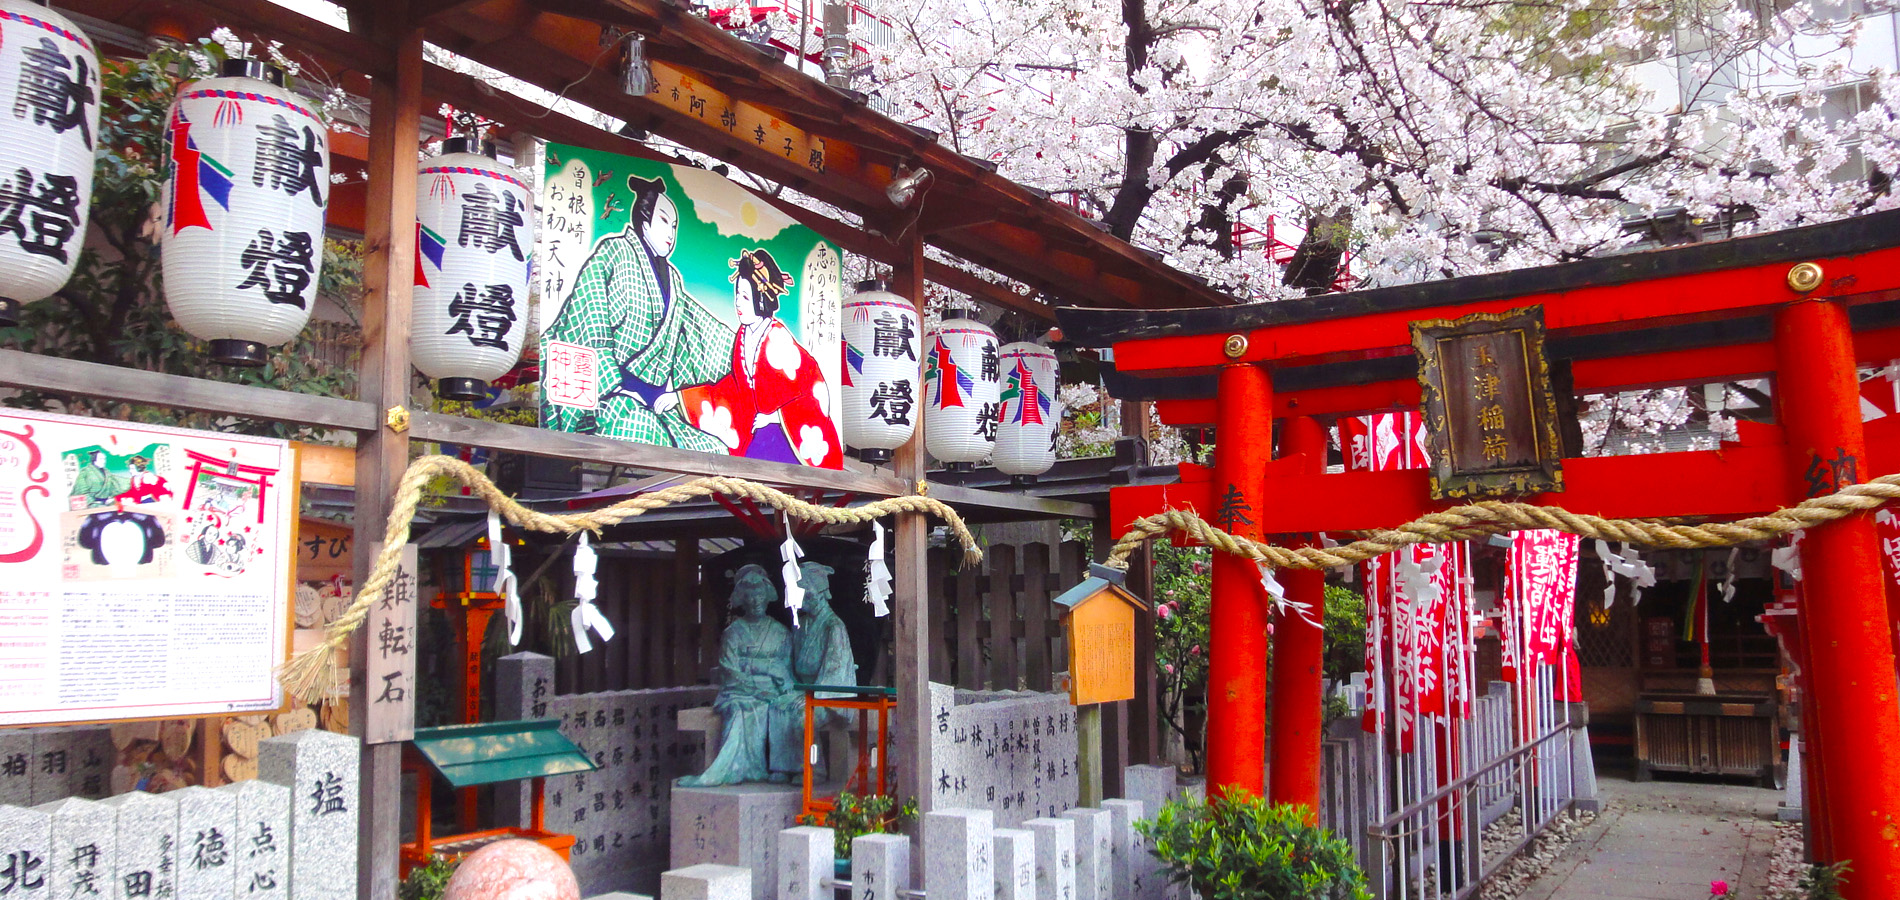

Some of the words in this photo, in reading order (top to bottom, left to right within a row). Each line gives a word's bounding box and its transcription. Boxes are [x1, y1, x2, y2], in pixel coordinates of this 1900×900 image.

[237, 114, 324, 310] 献燈
[545, 182, 566, 302] お初天神
[444, 182, 525, 352] 献燈
[868, 311, 917, 427] 献燈
[1470, 344, 1509, 461] 玉津稲荷
[1217, 483, 1255, 534] 奉
[311, 771, 347, 816] 塩
[0, 850, 45, 896] 北
[124, 870, 152, 898] 田
[187, 827, 228, 870] 徳
